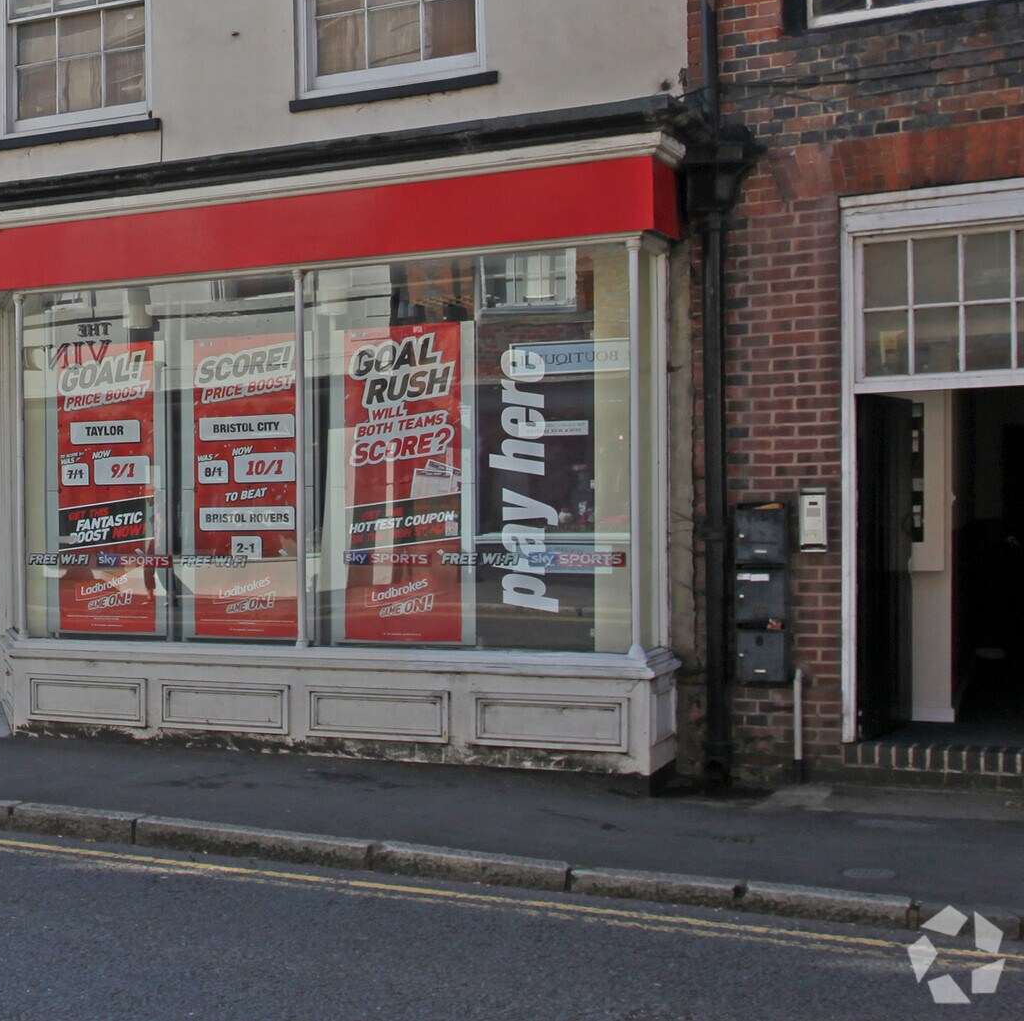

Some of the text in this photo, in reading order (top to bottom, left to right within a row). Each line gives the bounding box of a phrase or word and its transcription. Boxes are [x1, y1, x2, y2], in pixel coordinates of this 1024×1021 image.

[199, 346, 292, 384] SCORE!
[354, 337, 437, 376] GOAL
[62, 353, 142, 392] GOAL!
[205, 374, 293, 401] PRICE BOOST
[366, 366, 451, 405] RUSH
[66, 384, 147, 409] PRICE BOOST
[372, 405, 405, 420] WILL
[489, 349, 545, 476] here
[85, 425, 124, 436] TAYLOR
[213, 421, 280, 433] BRISTOL CITY
[357, 413, 444, 438] BOTH TEAMS
[197, 446, 253, 462] WAS NOW
[355, 428, 452, 463] SCORE?
[60, 450, 111, 465] WAS NOW
[111, 463, 135, 478] 9/1
[204, 460, 283, 477] 8/1 10/1
[225, 488, 267, 502] TO BEAT
[76, 511, 144, 532] FANTASTIC
[205, 513, 289, 523] BRISTOL ROVERS
[349, 510, 455, 534] HOTTEST COUPON
[69, 528, 110, 544] BOOST
[237, 543, 255, 553] 2-1
[29, 554, 58, 565] FREE
[98, 555, 169, 566] sky SPORTS
[180, 555, 213, 567] FREE
[345, 551, 428, 564] sky SPORTS
[441, 552, 477, 565] FREE
[530, 553, 623, 566] sky SPORTS
[80, 575, 128, 596] Ladbrokes
[219, 576, 271, 599] Ladbrokes
[371, 577, 429, 602] Ladbrokes
[108, 589, 133, 607] ON!
[248, 591, 276, 609] ON!
[379, 594, 434, 618] GAME ON!
